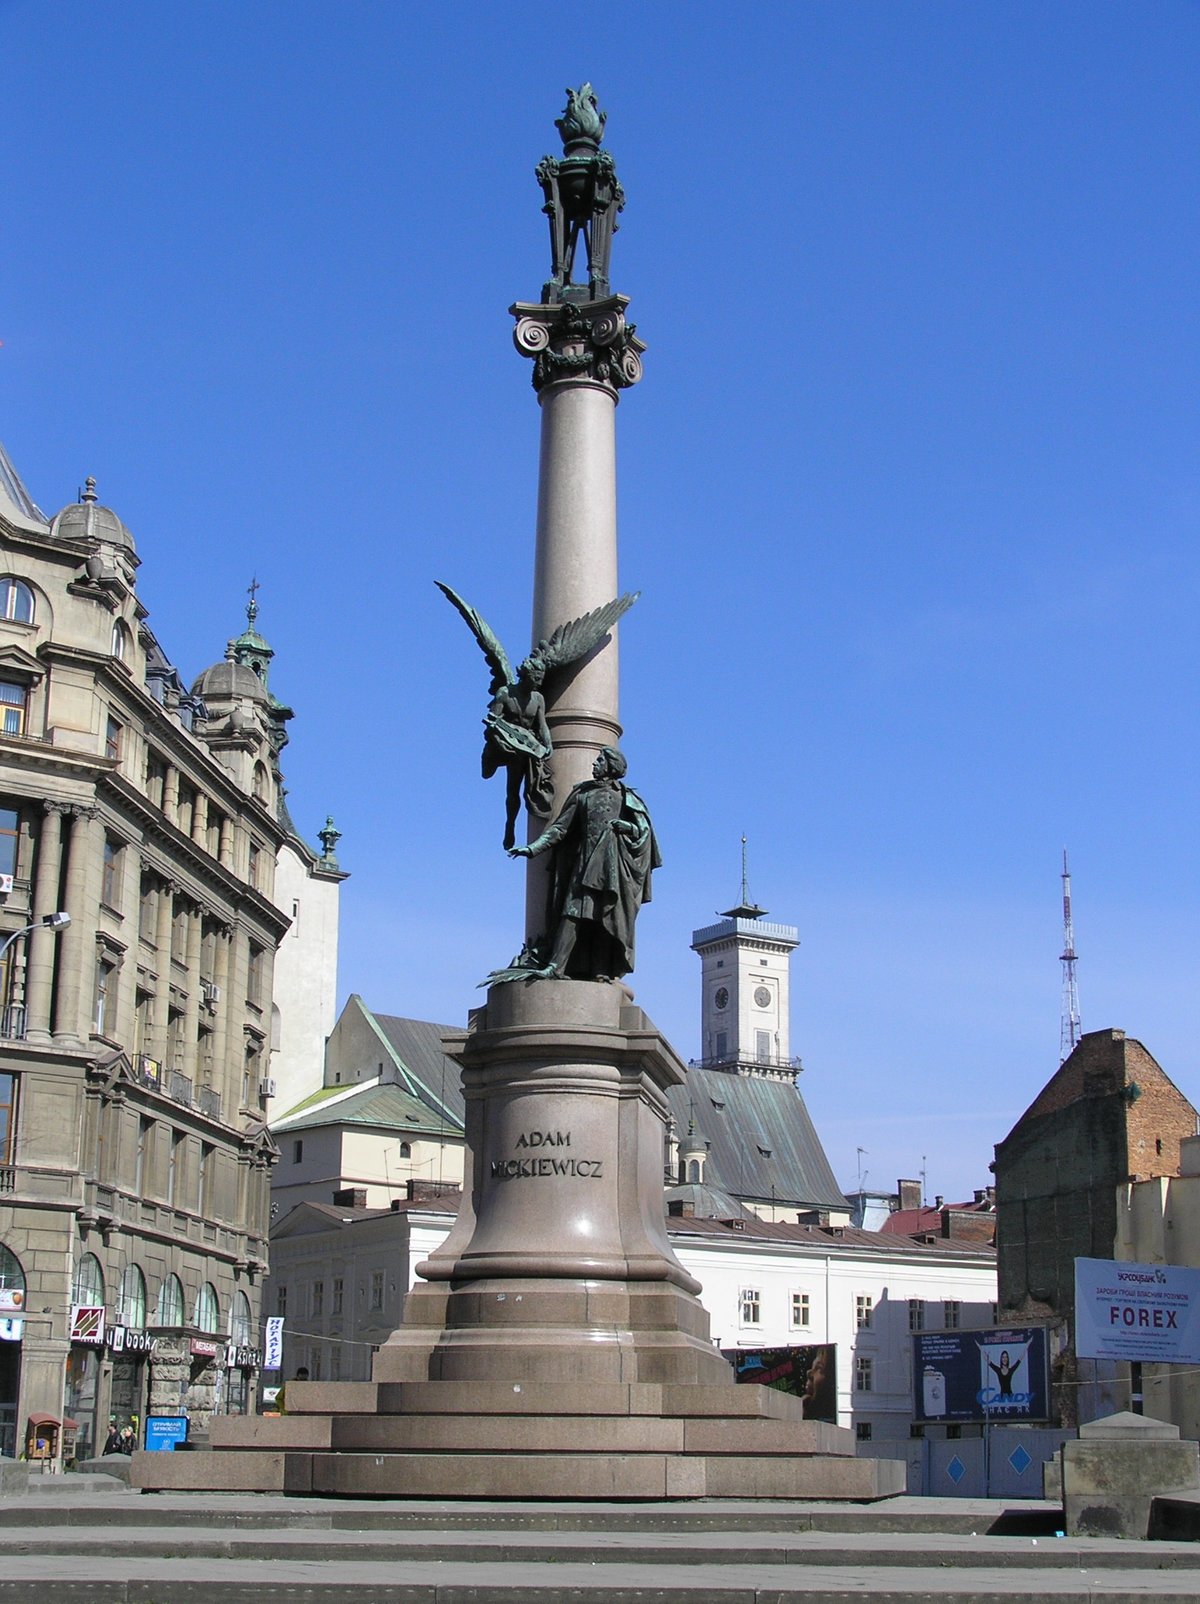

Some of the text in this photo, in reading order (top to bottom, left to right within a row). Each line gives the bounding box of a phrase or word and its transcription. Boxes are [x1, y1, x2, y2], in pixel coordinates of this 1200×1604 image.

[515, 1131, 571, 1148] ADAM
[490, 1158, 603, 1179] MICKIEWICZ
[1110, 1306, 1178, 1329] FOREX
